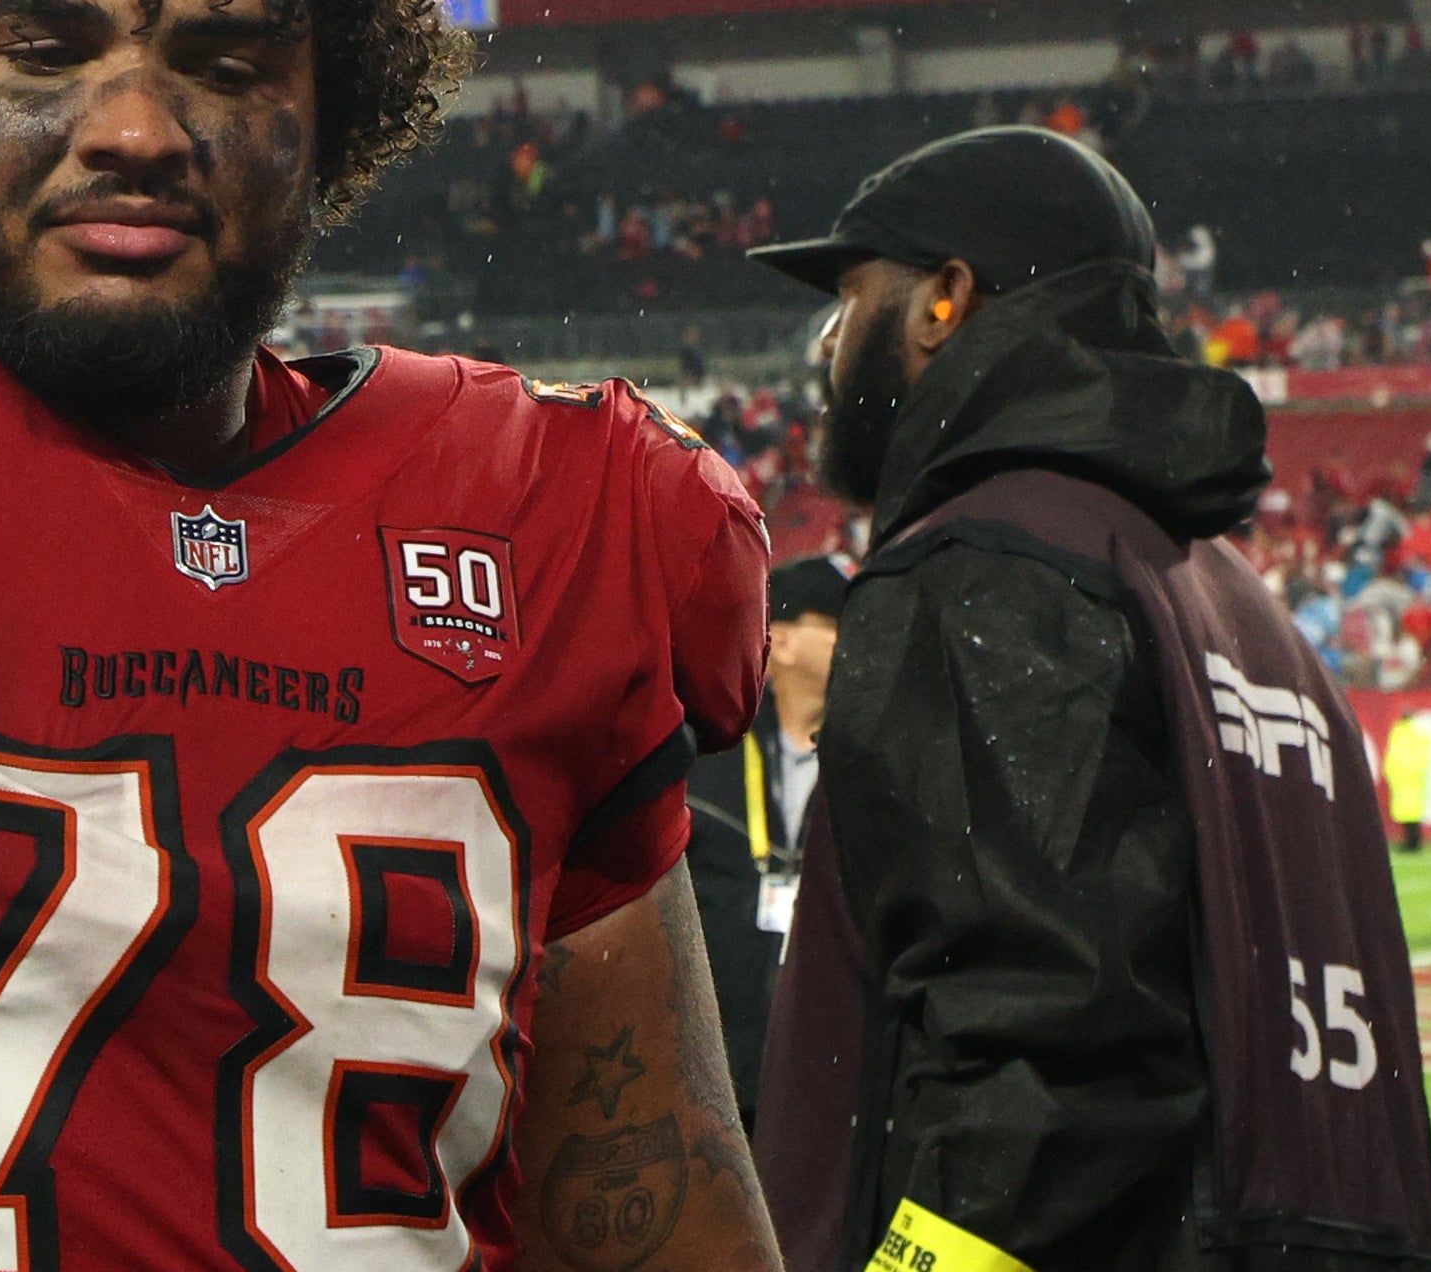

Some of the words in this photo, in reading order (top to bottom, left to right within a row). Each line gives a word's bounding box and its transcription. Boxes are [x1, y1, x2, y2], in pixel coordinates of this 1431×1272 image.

[185, 540, 239, 575] NFL
[401, 541, 502, 619] 50
[425, 615, 494, 637] SEASONS
[59, 645, 366, 724] BUCCANEERS
